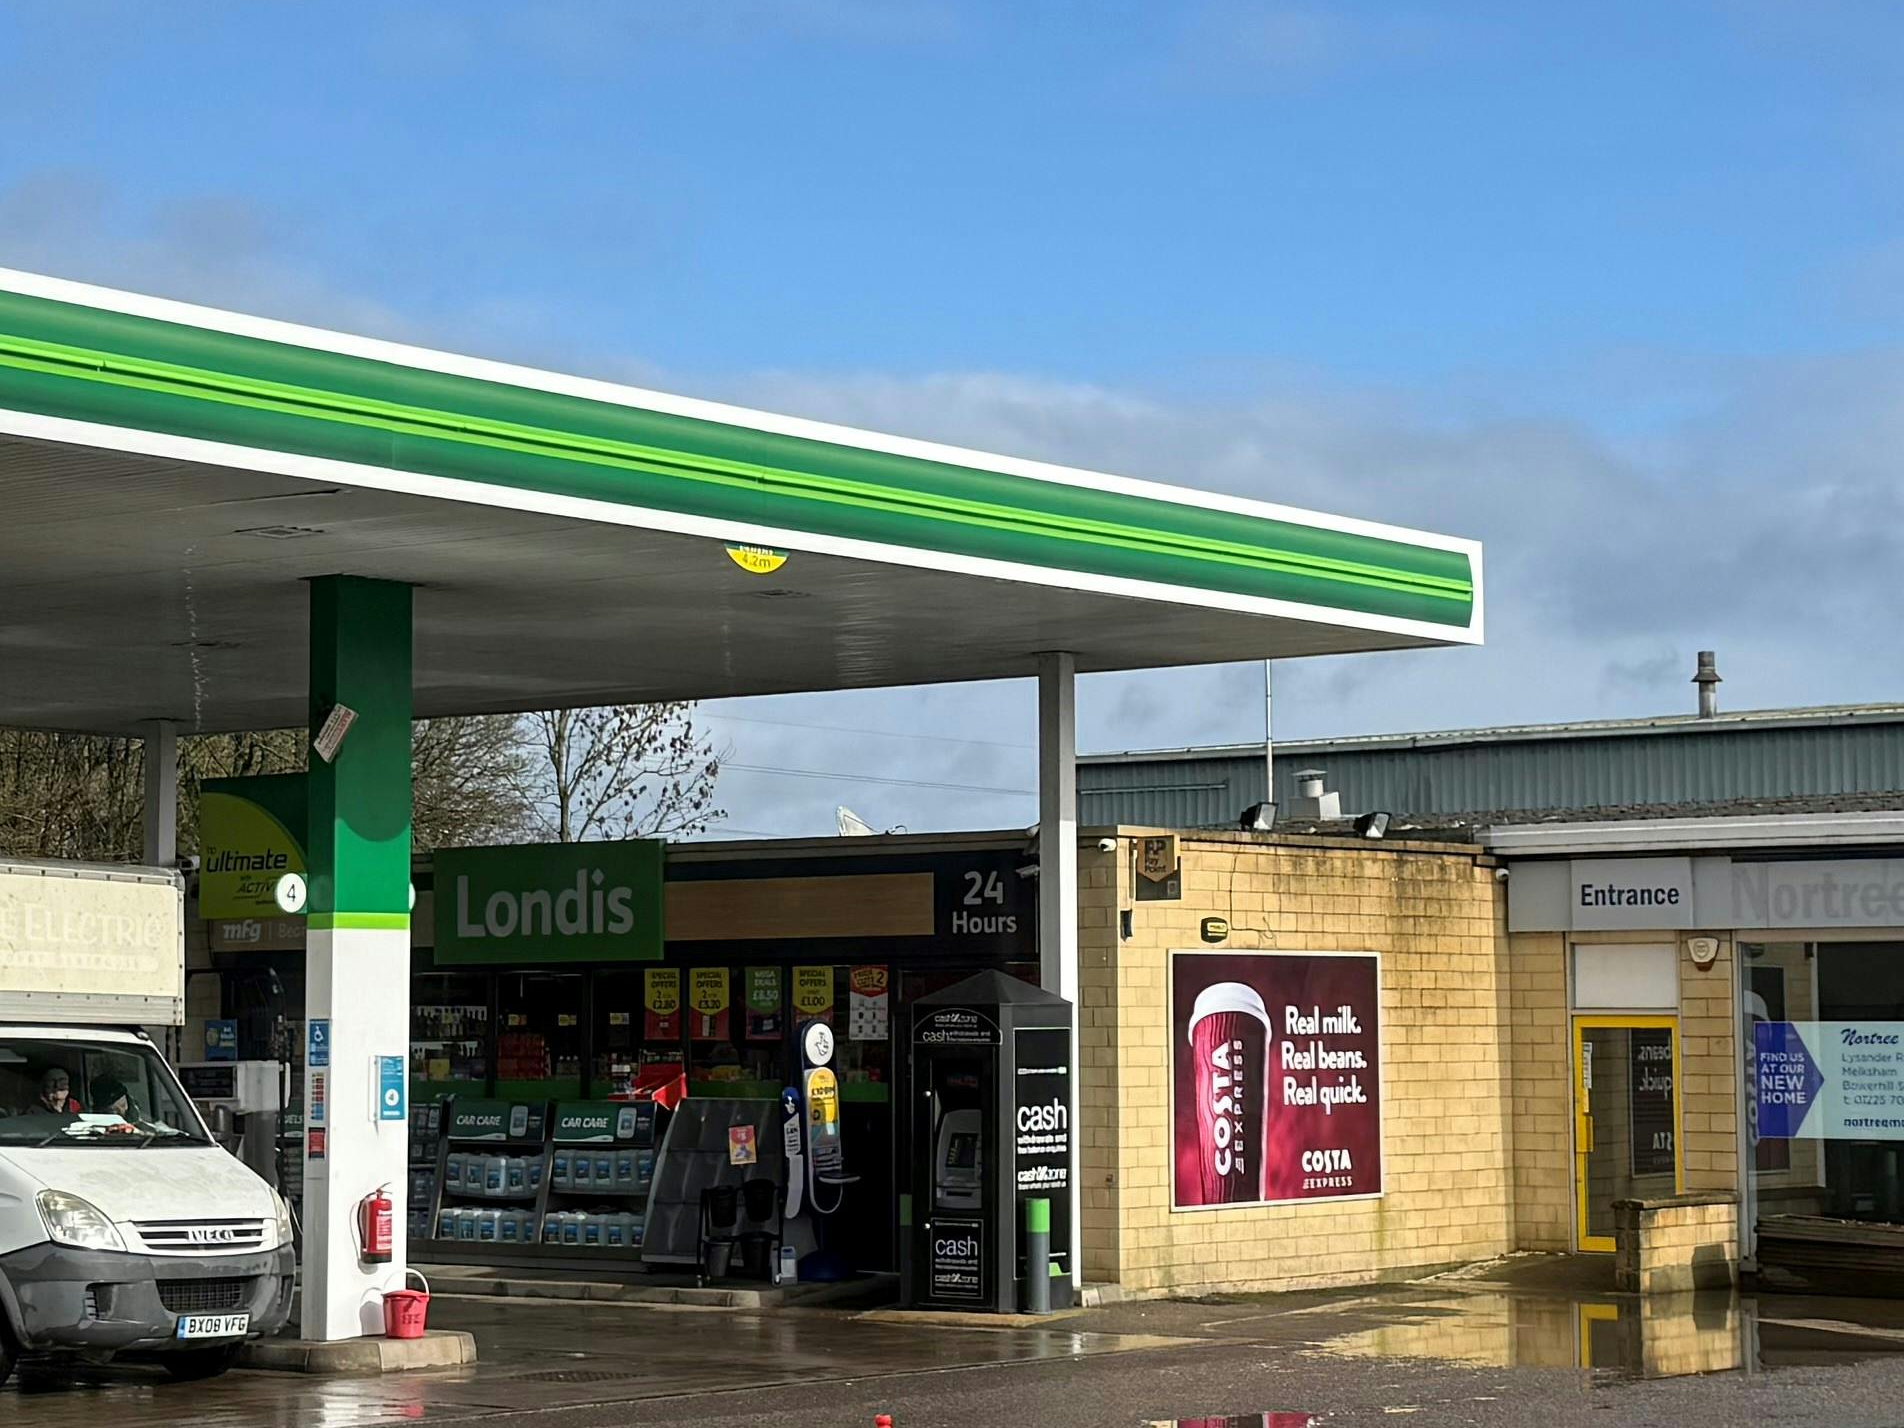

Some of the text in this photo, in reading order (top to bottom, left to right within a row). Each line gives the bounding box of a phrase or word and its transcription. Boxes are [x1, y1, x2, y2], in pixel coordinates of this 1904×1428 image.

[206, 849, 288, 872] ultimate
[286, 883, 296, 902] 4
[963, 871, 1004, 905] 24
[1580, 883, 1680, 907] Entrance
[457, 869, 634, 938] Londis
[952, 911, 1017, 935] Hours
[1285, 1005, 1362, 1035] Real milk.
[922, 1029, 949, 1043] cash
[1839, 1028, 1900, 1047] Nortree
[1281, 1040, 1368, 1070] Real beans.
[1760, 1063, 1805, 1074] AT OUR
[1760, 1075, 1805, 1090] NEW
[1283, 1074, 1368, 1115] Real quick.
[1761, 1091, 1807, 1104] HOME
[1017, 1097, 1068, 1132] cash
[1211, 1042, 1233, 1176] COSTA
[561, 1117, 609, 1129] CAR CARE
[1301, 1149, 1352, 1174] COSTA
[188, 1228, 234, 1242] IVECO
[935, 1235, 978, 1257] cash
[188, 1316, 247, 1334] BX08 VFG
